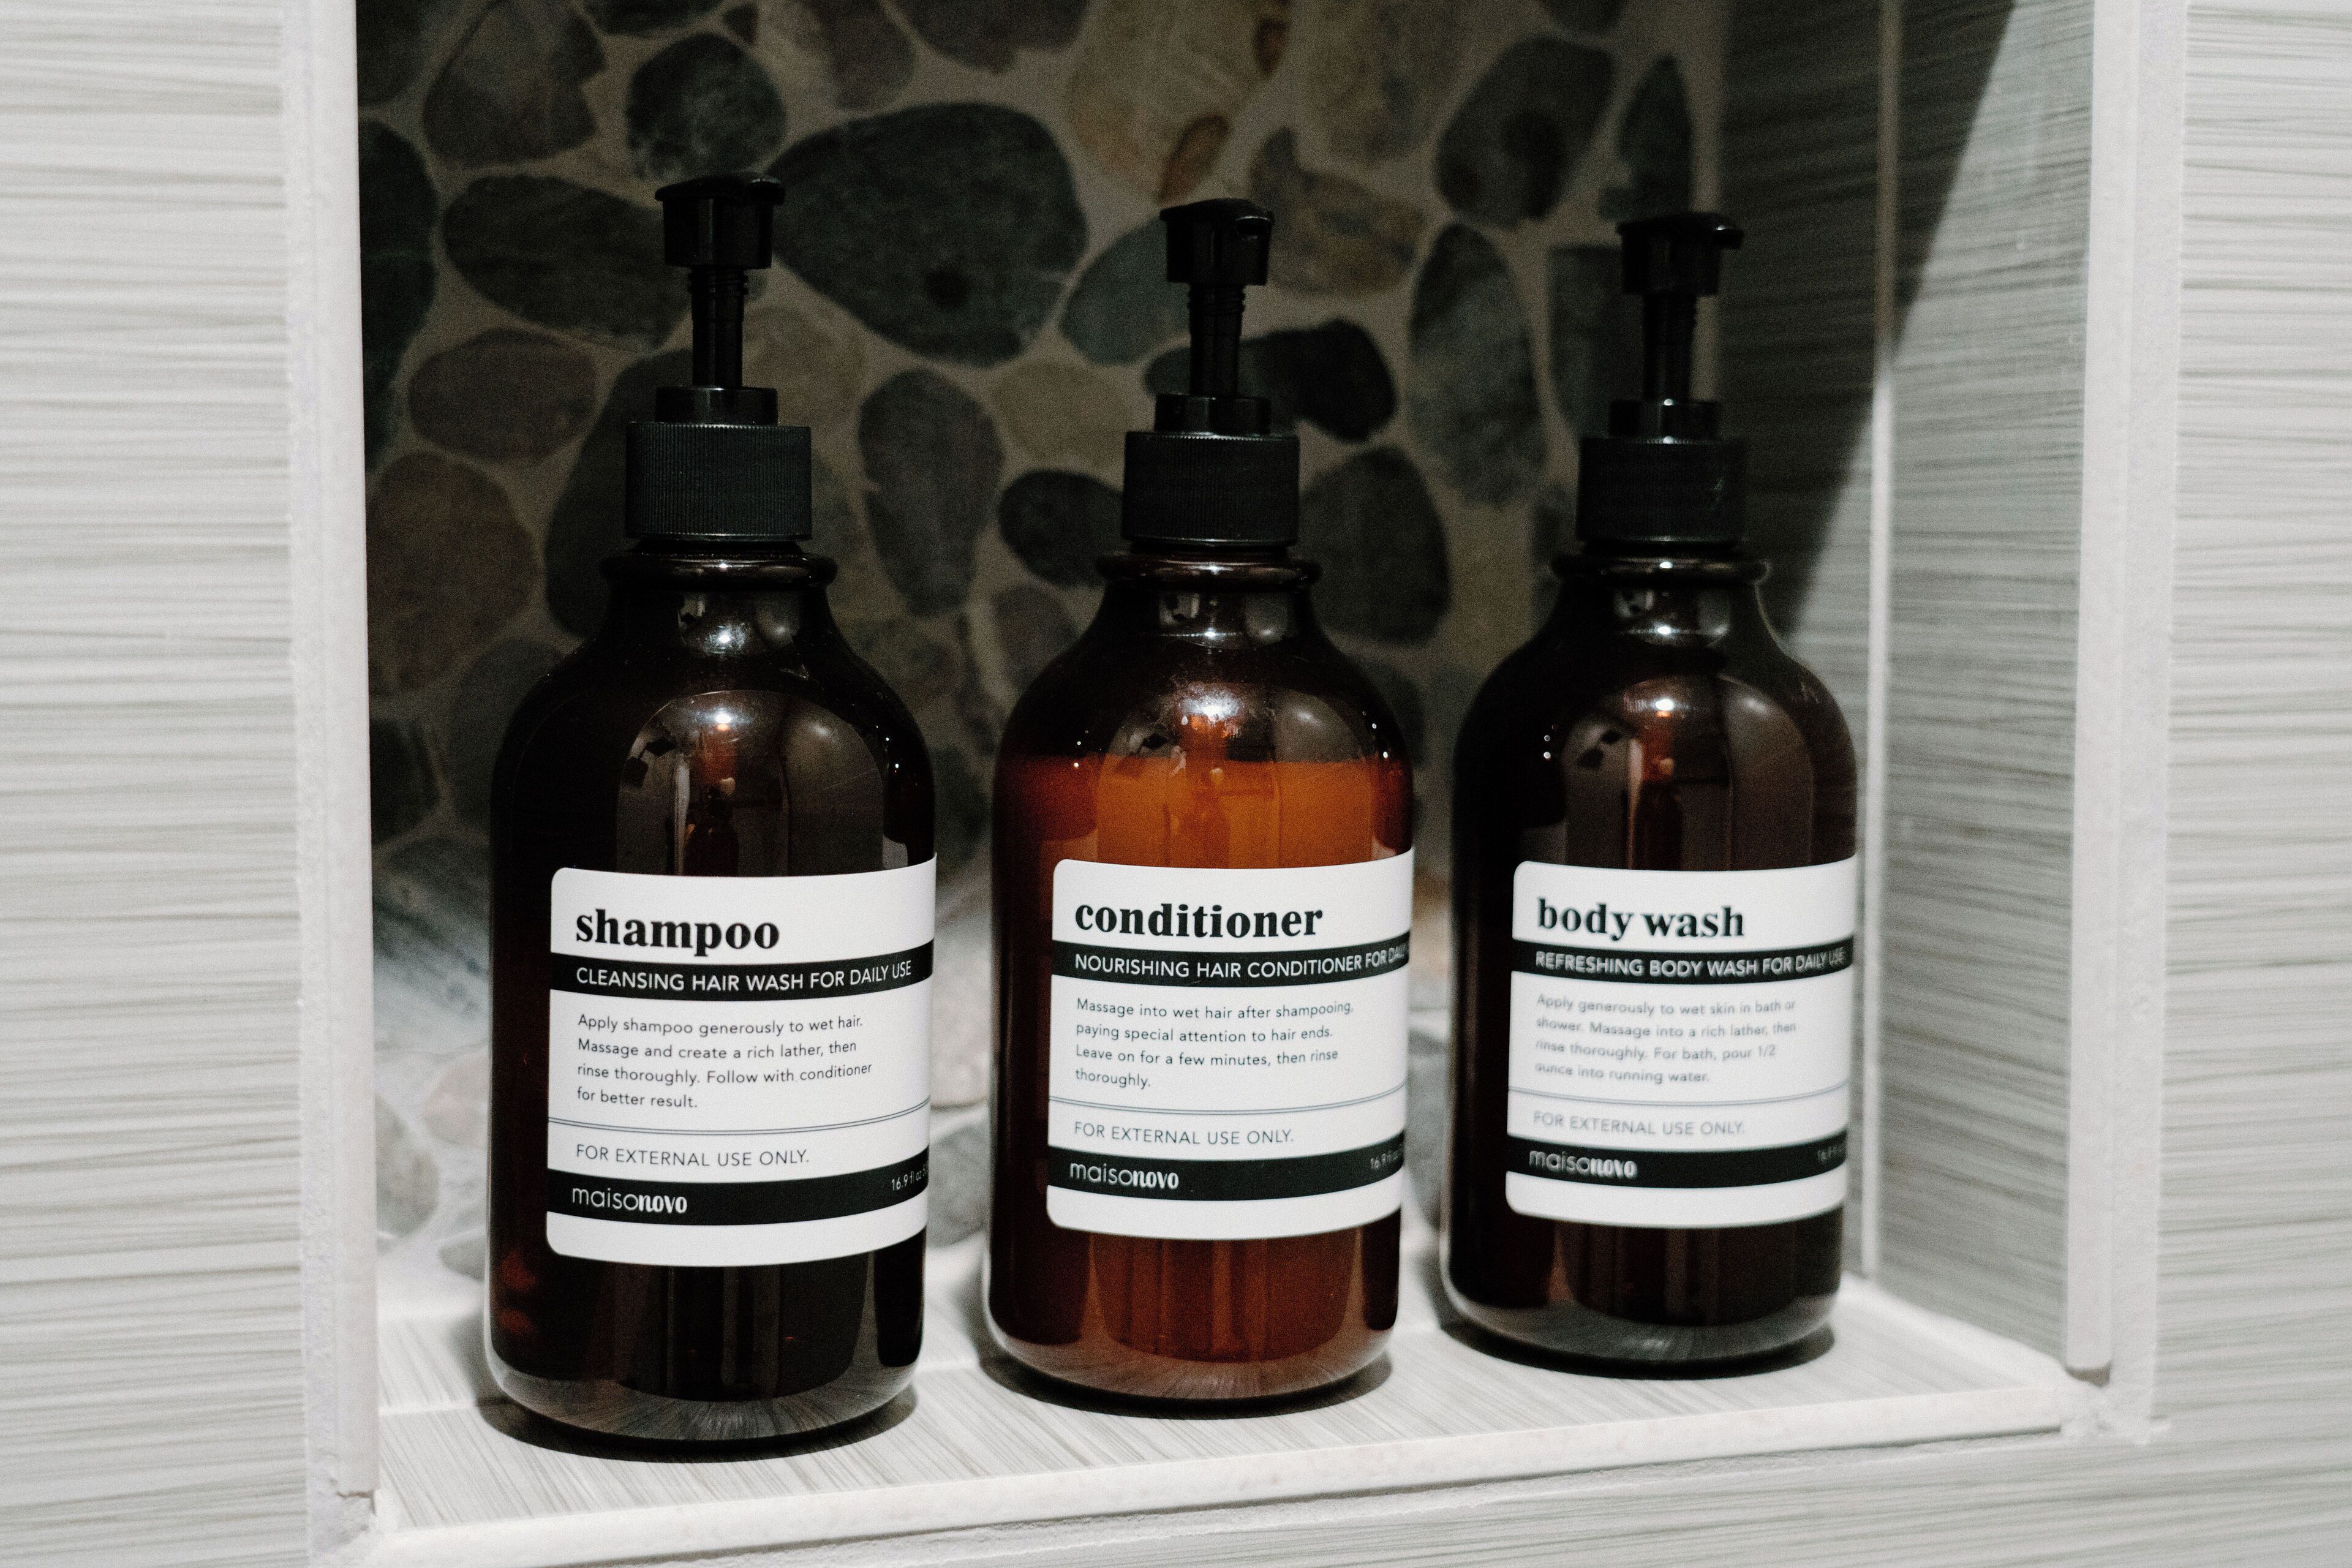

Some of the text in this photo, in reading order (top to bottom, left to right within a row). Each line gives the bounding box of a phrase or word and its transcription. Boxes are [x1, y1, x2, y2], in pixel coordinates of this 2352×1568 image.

[1076, 903, 1322, 938] conditioner
[1538, 898, 1743, 941] body wash
[576, 908, 779, 957] shampoo
[577, 960, 911, 991] CLEANSING HAIR WASH FOR DAILY USE
[1076, 954, 1189, 978] NOURISHING
[1197, 962, 1241, 978] HAIR
[1248, 955, 1362, 978] CONDITIONER
[1365, 950, 1387, 967] FOR
[1536, 951, 1643, 976] REFRESHING
[1650, 960, 1703, 977] BODY
[1707, 960, 1758, 976] WASH
[1763, 957, 1793, 974] FOR
[1795, 953, 1826, 971] DAILY
[1077, 998, 1353, 1019] Massage into wet hair after shampooing,
[1537, 994, 1573, 1011] Apply
[1578, 1001, 1654, 1017] generously
[1660, 1005, 1675, 1015] to
[1680, 1005, 1705, 1015] wet
[1710, 1002, 1735, 1014] skin
[1740, 1001, 1751, 1013] in
[1755, 1001, 1781, 1012] bath
[578, 1014, 862, 1038] Apply shampoo generously to wet hair.
[1076, 1024, 1332, 1042] paying special attention to hair ends.
[1590, 1022, 1651, 1039] Massage
[1656, 1025, 1684, 1038] into
[1701, 1025, 1726, 1038] rich
[1731, 1023, 1768, 1036] lather,
[1773, 1023, 1796, 1033] then
[578, 1038, 856, 1058] Massage and create a rich lather, then
[1076, 1045, 1112, 1060] Leave
[1118, 1053, 1134, 1061] on
[1140, 1050, 1159, 1063] for
[1179, 1052, 1204, 1065] few
[1210, 1053, 1270, 1066] minutes,
[1276, 1052, 1305, 1064] then
[1311, 1050, 1338, 1061] rinse
[1536, 1041, 1565, 1052] rinse
[1654, 1047, 1676, 1060] For
[1682, 1048, 1716, 1060] bath,
[1722, 1048, 1752, 1061] pour
[1758, 1044, 1776, 1057] 1/2
[578, 1063, 872, 1087] rinse thoroughly. Follow with conditioner
[1075, 1068, 1150, 1090] thoroughly.
[1535, 1063, 1573, 1076] ounce
[1578, 1068, 1604, 1079] into
[1609, 1071, 1664, 1085] running
[577, 1086, 696, 1107] for better result.
[1074, 1121, 1293, 1145] FOR EXTERNAL USE ONLY.
[1534, 1110, 1564, 1126] FOR
[1570, 1116, 1656, 1135] EXTERNAL
[1662, 1121, 1694, 1136] USE
[576, 1144, 809, 1167] FOR EXTERNAL USE ONLY.
[1529, 1150, 1637, 1180] maisonovo
[1071, 1163, 1178, 1189] maisonovo
[573, 1188, 687, 1213] maisonovo
